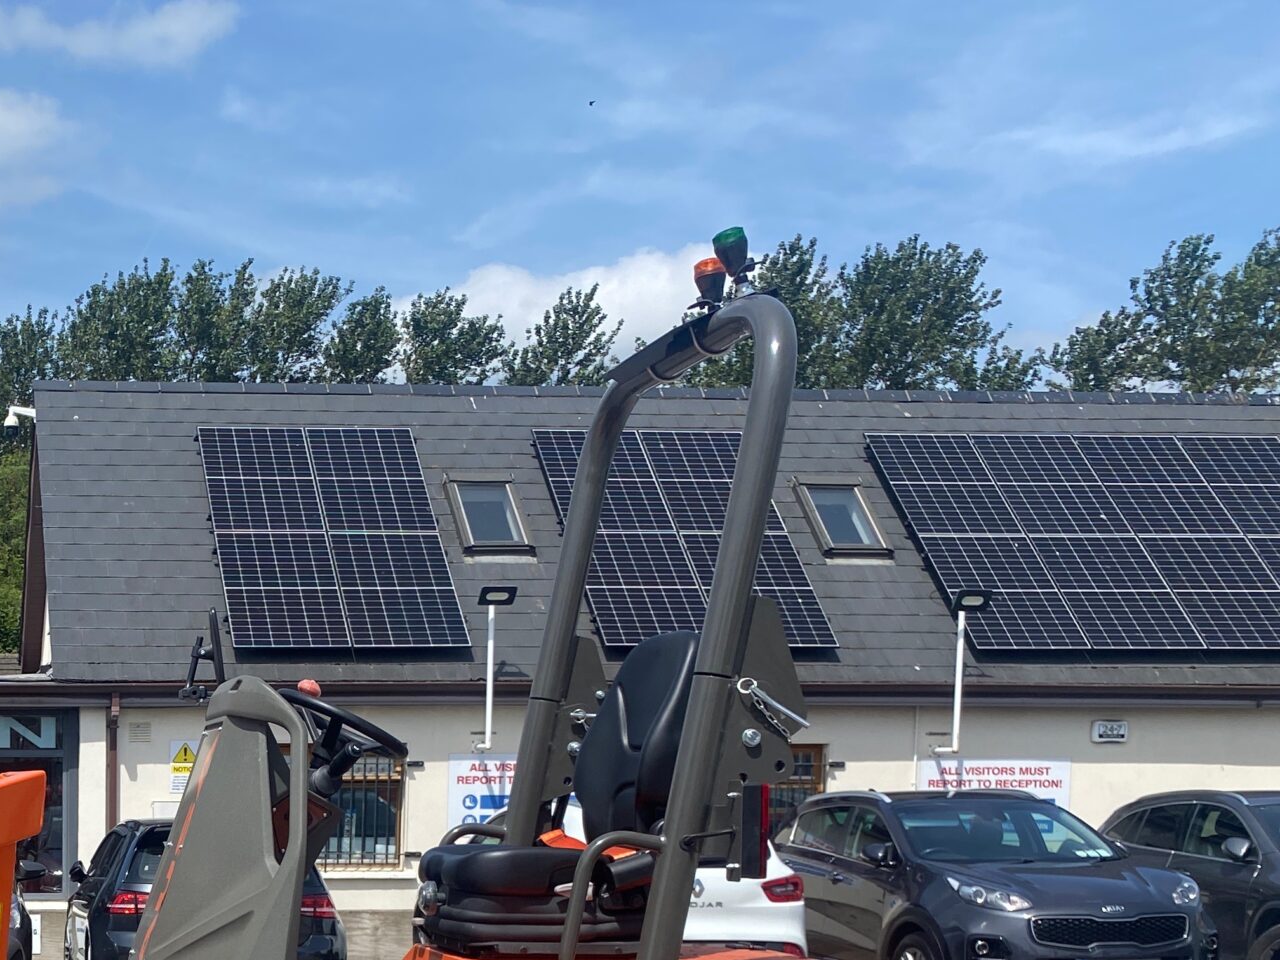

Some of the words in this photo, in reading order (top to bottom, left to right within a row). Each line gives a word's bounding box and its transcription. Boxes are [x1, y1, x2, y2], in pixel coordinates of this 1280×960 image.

[470, 763, 492, 772] ALL
[940, 766, 960, 776] ALL
[964, 766, 1016, 776] VISITORS
[1019, 766, 1051, 776] MUST
[456, 775, 504, 785] REPORT
[927, 779, 974, 789] REPORT
[976, 779, 992, 789] TO
[994, 779, 1063, 789] RECEPTION!
